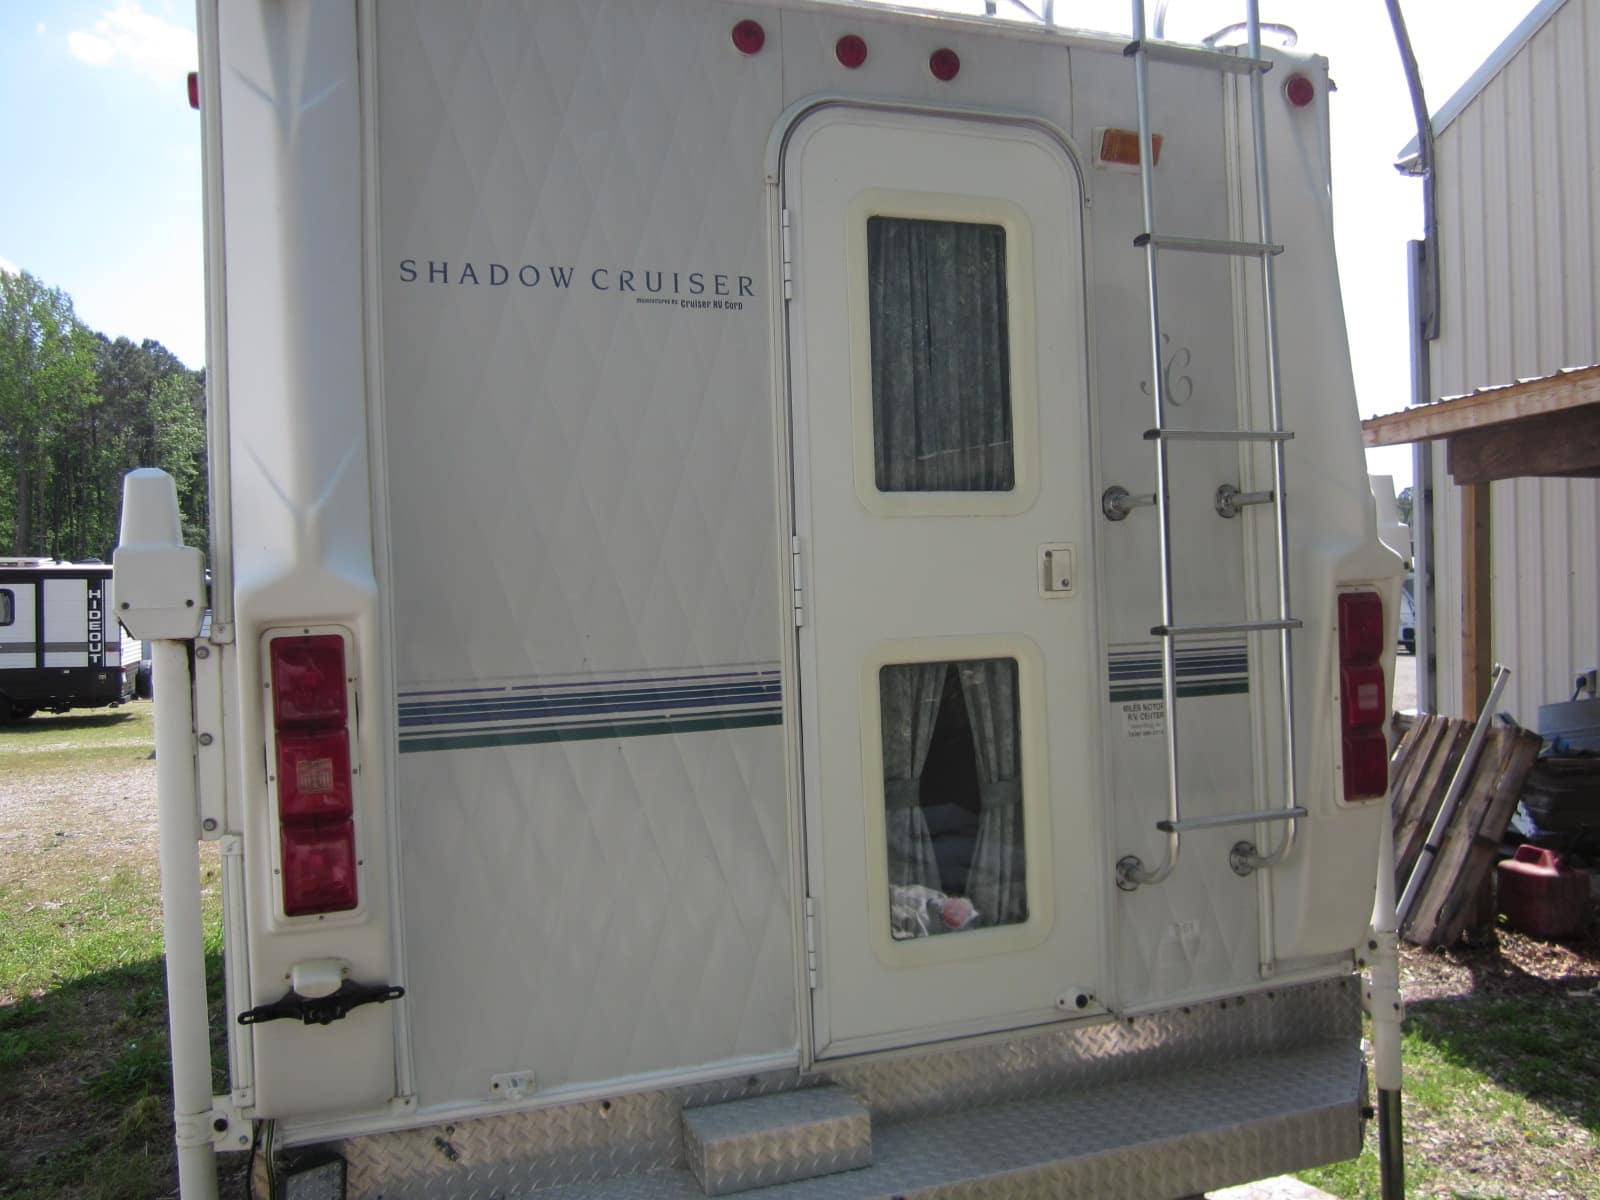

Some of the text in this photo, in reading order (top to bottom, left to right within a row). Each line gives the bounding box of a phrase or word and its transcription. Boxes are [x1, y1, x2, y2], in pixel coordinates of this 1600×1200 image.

[399, 259, 755, 297] SHADOW CRUISER
[680, 299, 711, 309] Cruiser
[712, 300, 723, 310] RV
[88, 589, 102, 664] HIDEOUT
